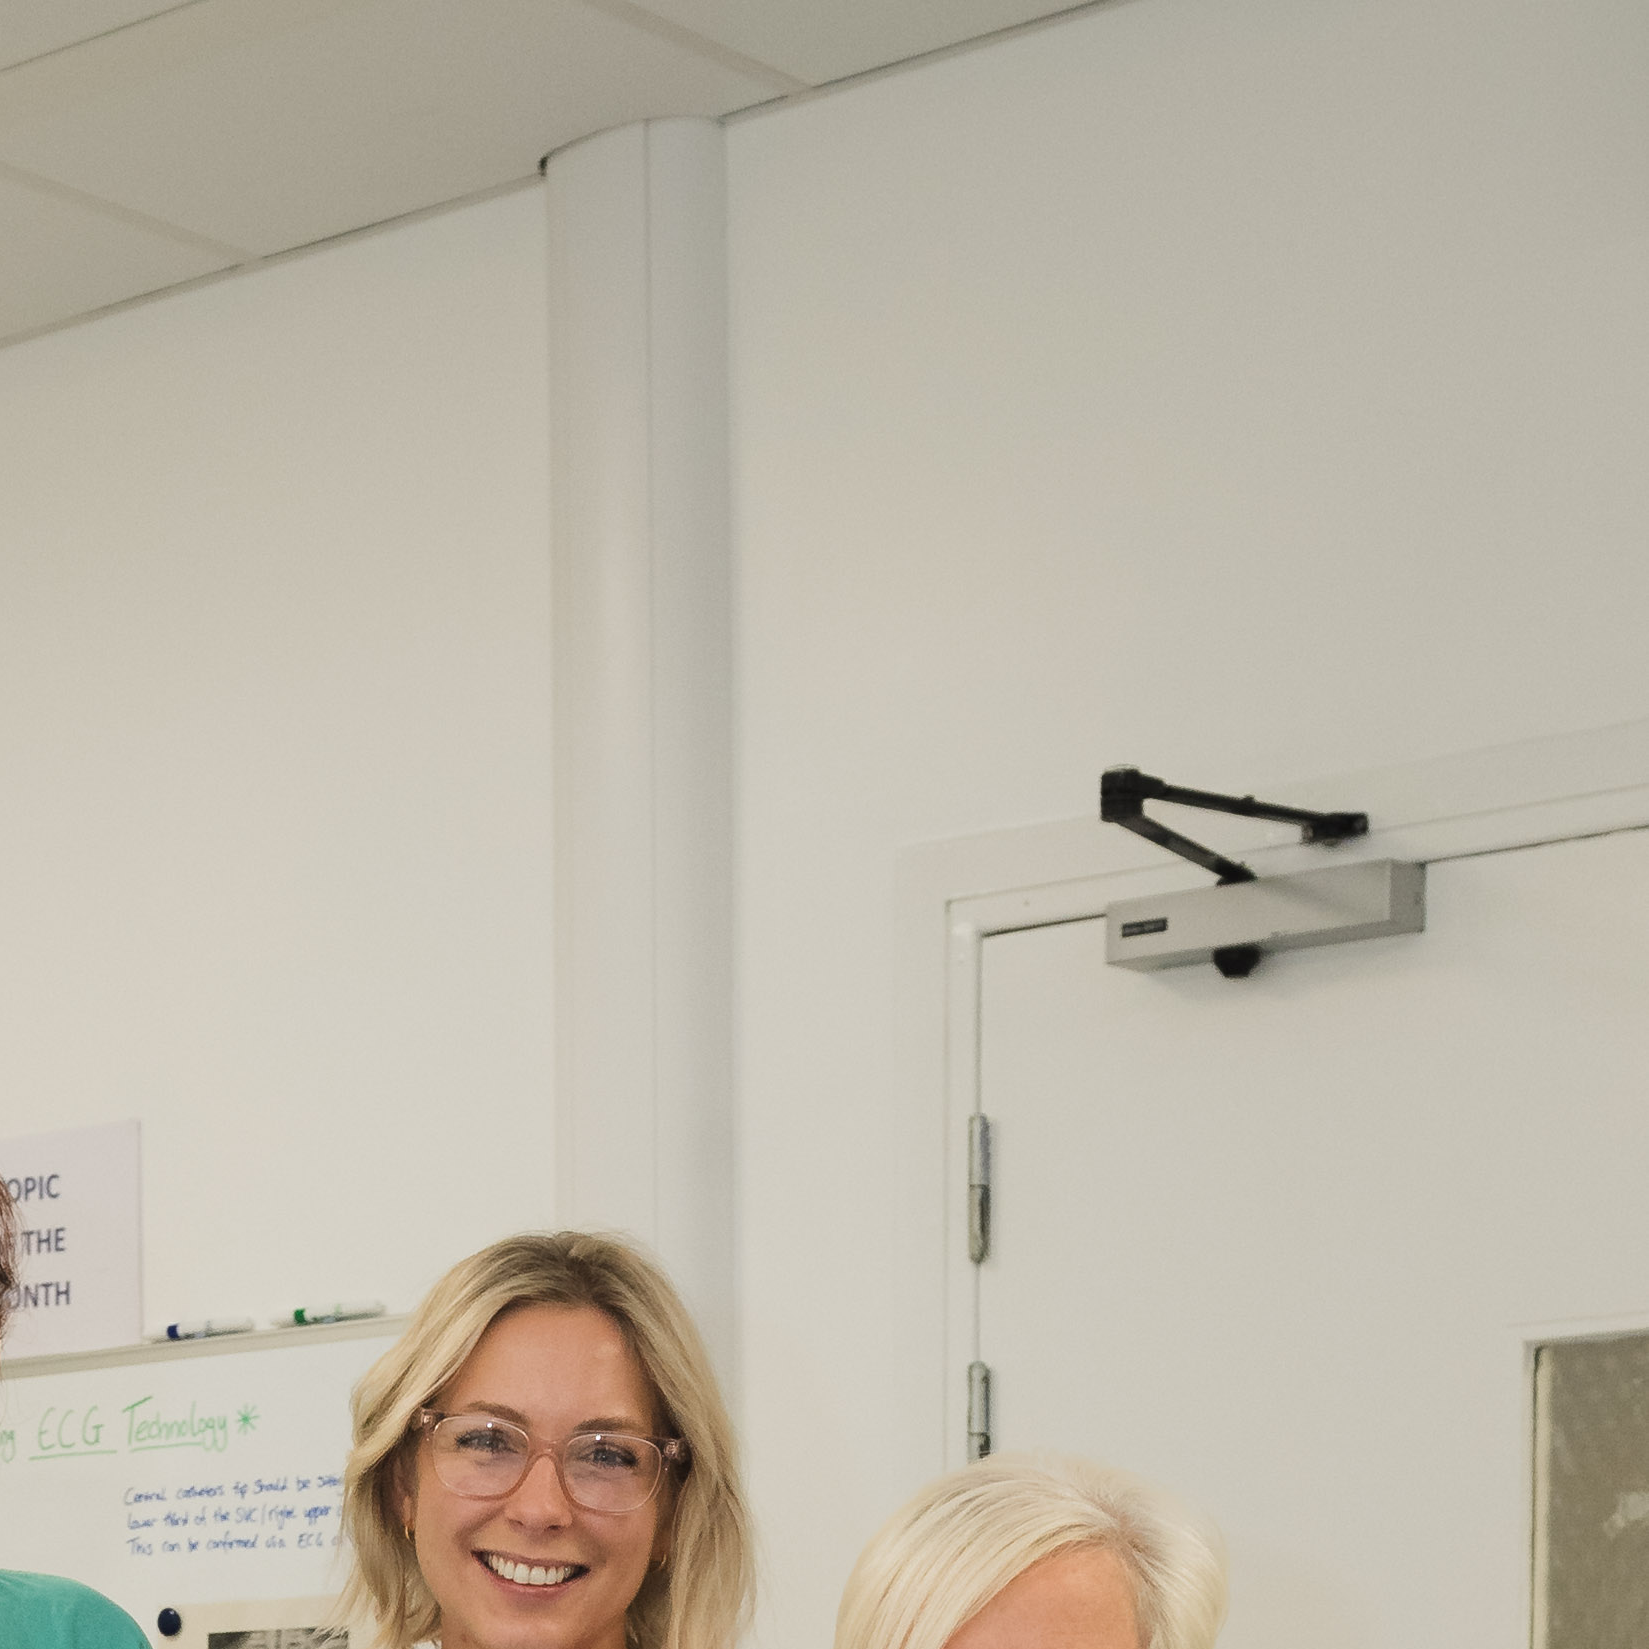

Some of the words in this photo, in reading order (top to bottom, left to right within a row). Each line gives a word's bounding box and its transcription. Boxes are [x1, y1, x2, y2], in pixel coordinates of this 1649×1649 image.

[6, 1174, 60, 1202] OPIC
[21, 1226, 66, 1256] THE
[2, 1280, 72, 1310] ONTH
[37, 1405, 105, 1451] ECG
[122, 1395, 229, 1453] Technology
